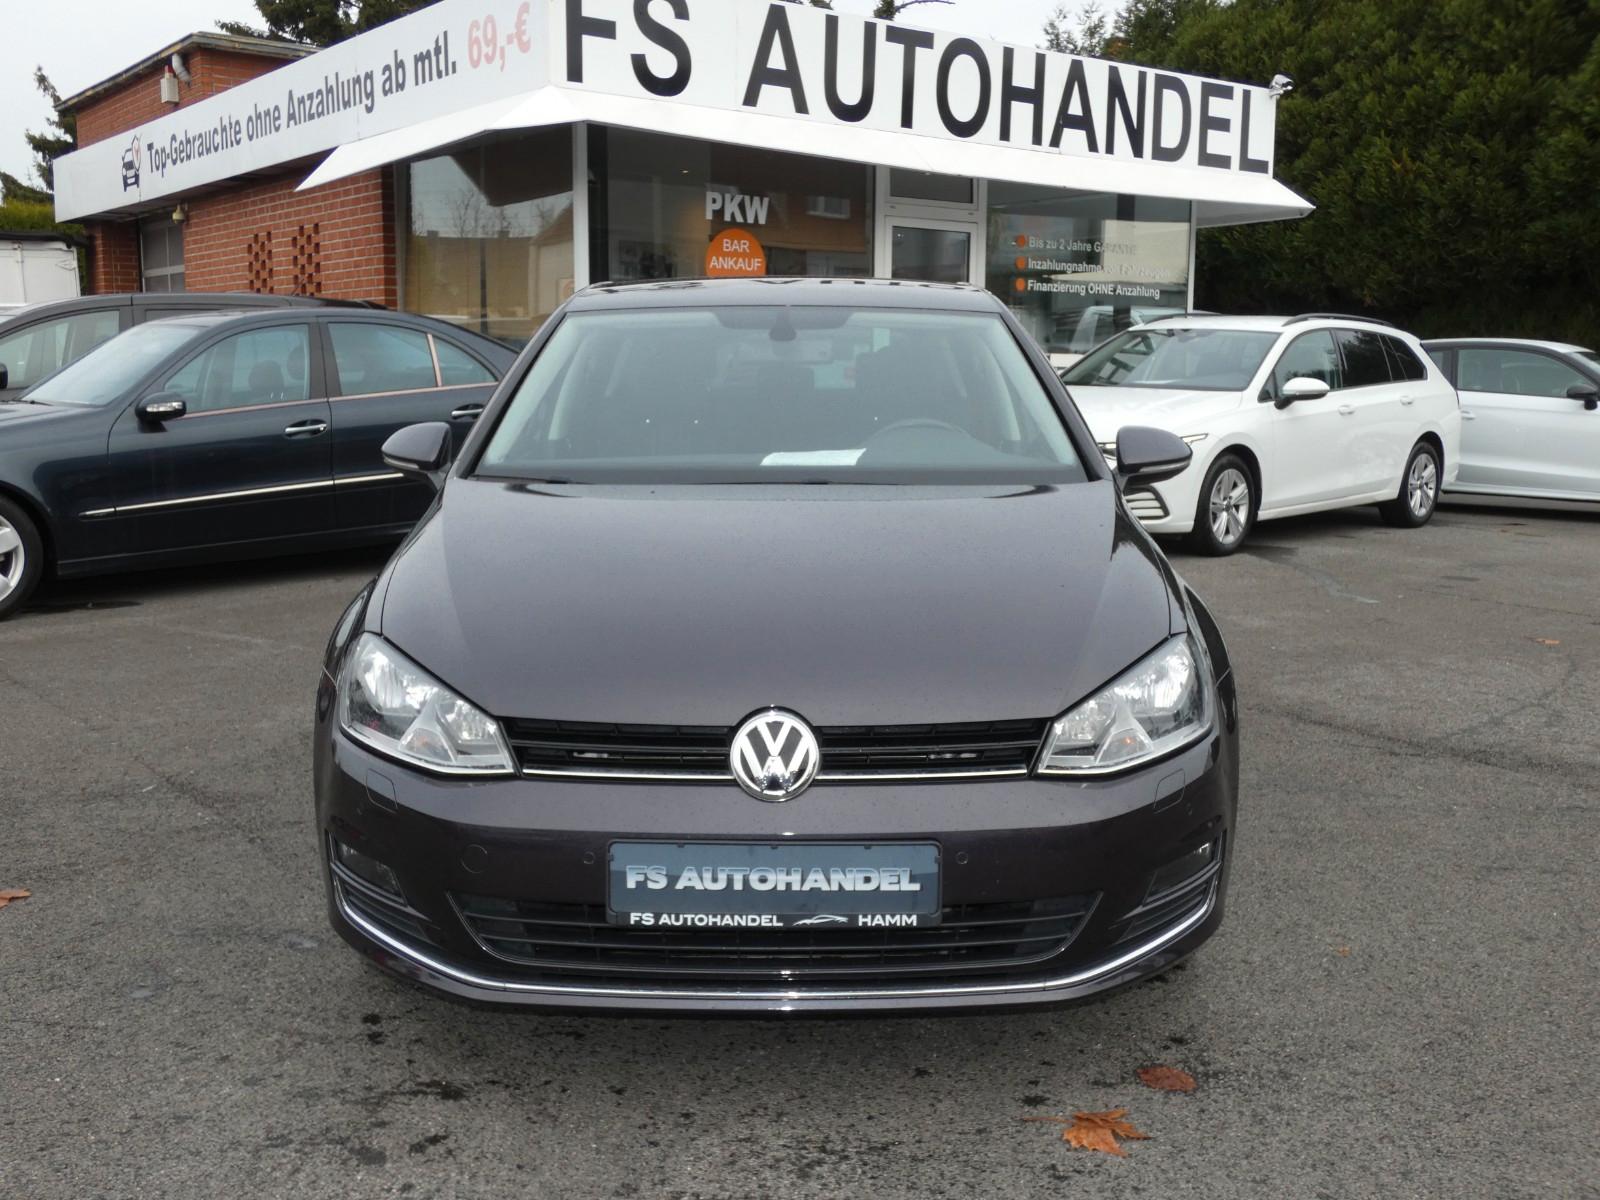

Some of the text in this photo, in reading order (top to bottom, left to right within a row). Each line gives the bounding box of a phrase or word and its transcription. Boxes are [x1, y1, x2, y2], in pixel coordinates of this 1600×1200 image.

[146, 1, 532, 178] Top-Gebrauchte ohne Anzahlung ab mtl. 69,-€
[565, 0, 1269, 174] FS AUTOHANDEL
[705, 191, 770, 225] PKW
[722, 238, 750, 253] BAR
[1028, 236, 1045, 249] Bis
[1046, 239, 1057, 249] zu
[1059, 238, 1066, 250] 2
[1067, 239, 1092, 252] Jahre
[709, 255, 762, 271] ANKAUF
[1027, 279, 1160, 300] Finanzierung OHNE Anzahlung
[626, 865, 921, 892] FS AUTOHANDEL
[629, 912, 918, 928] FS AUTOHANDEL HAMM
